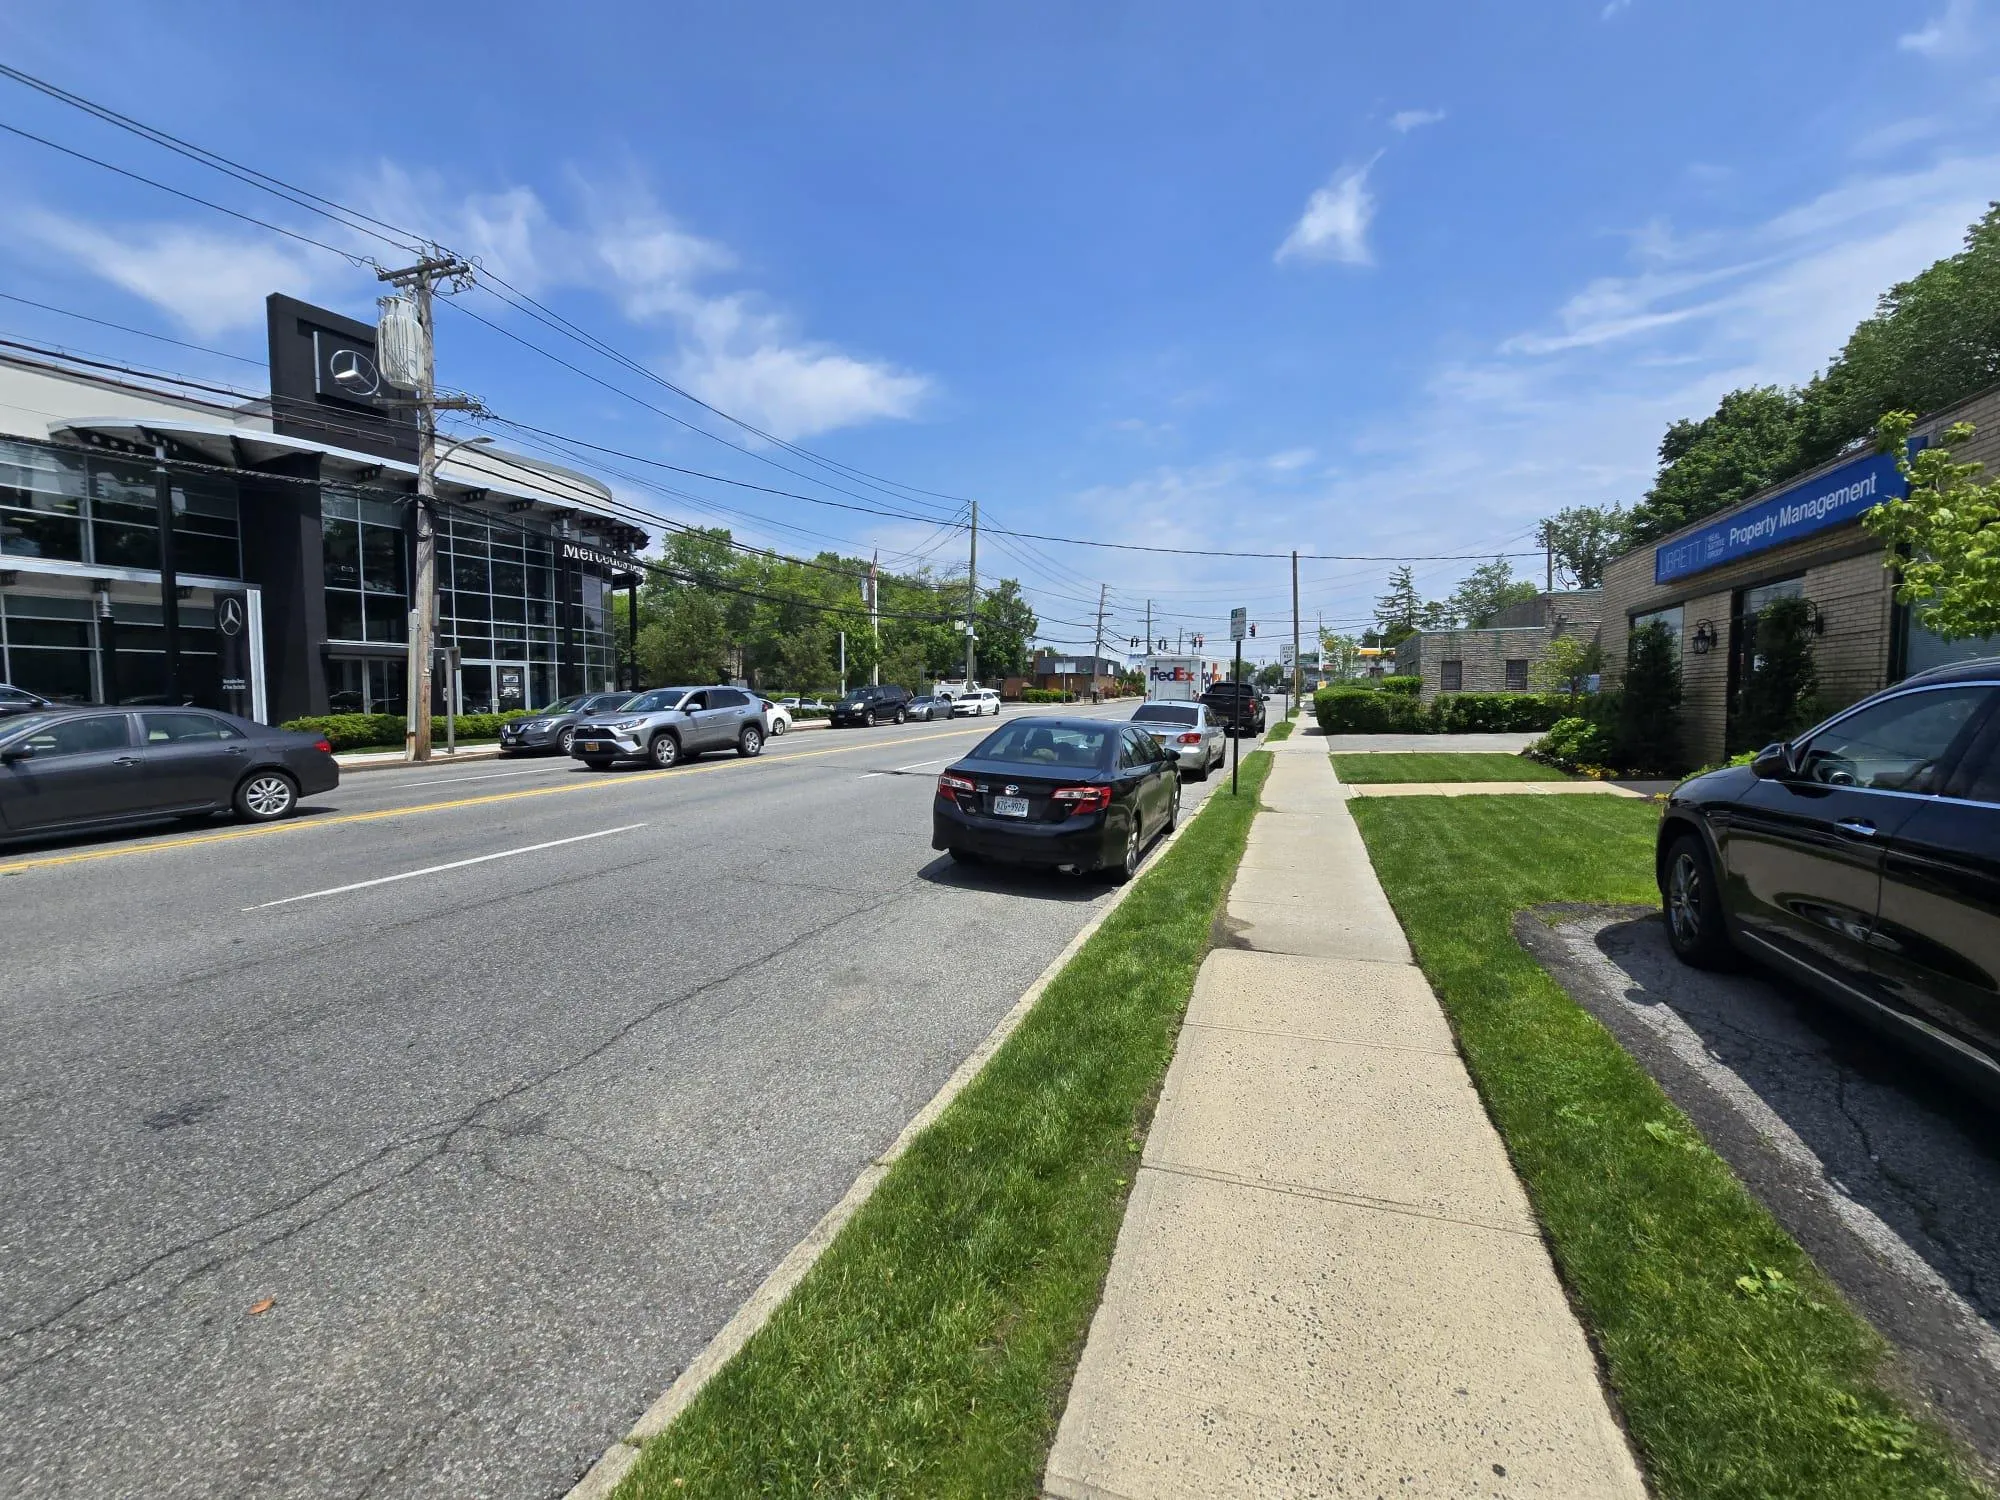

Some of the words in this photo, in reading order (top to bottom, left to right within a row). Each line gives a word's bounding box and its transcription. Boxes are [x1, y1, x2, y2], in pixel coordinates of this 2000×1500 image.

[1729, 514, 1778, 547] Property
[1779, 472, 1877, 528] Management
[1150, 666, 1195, 682] FedEx
